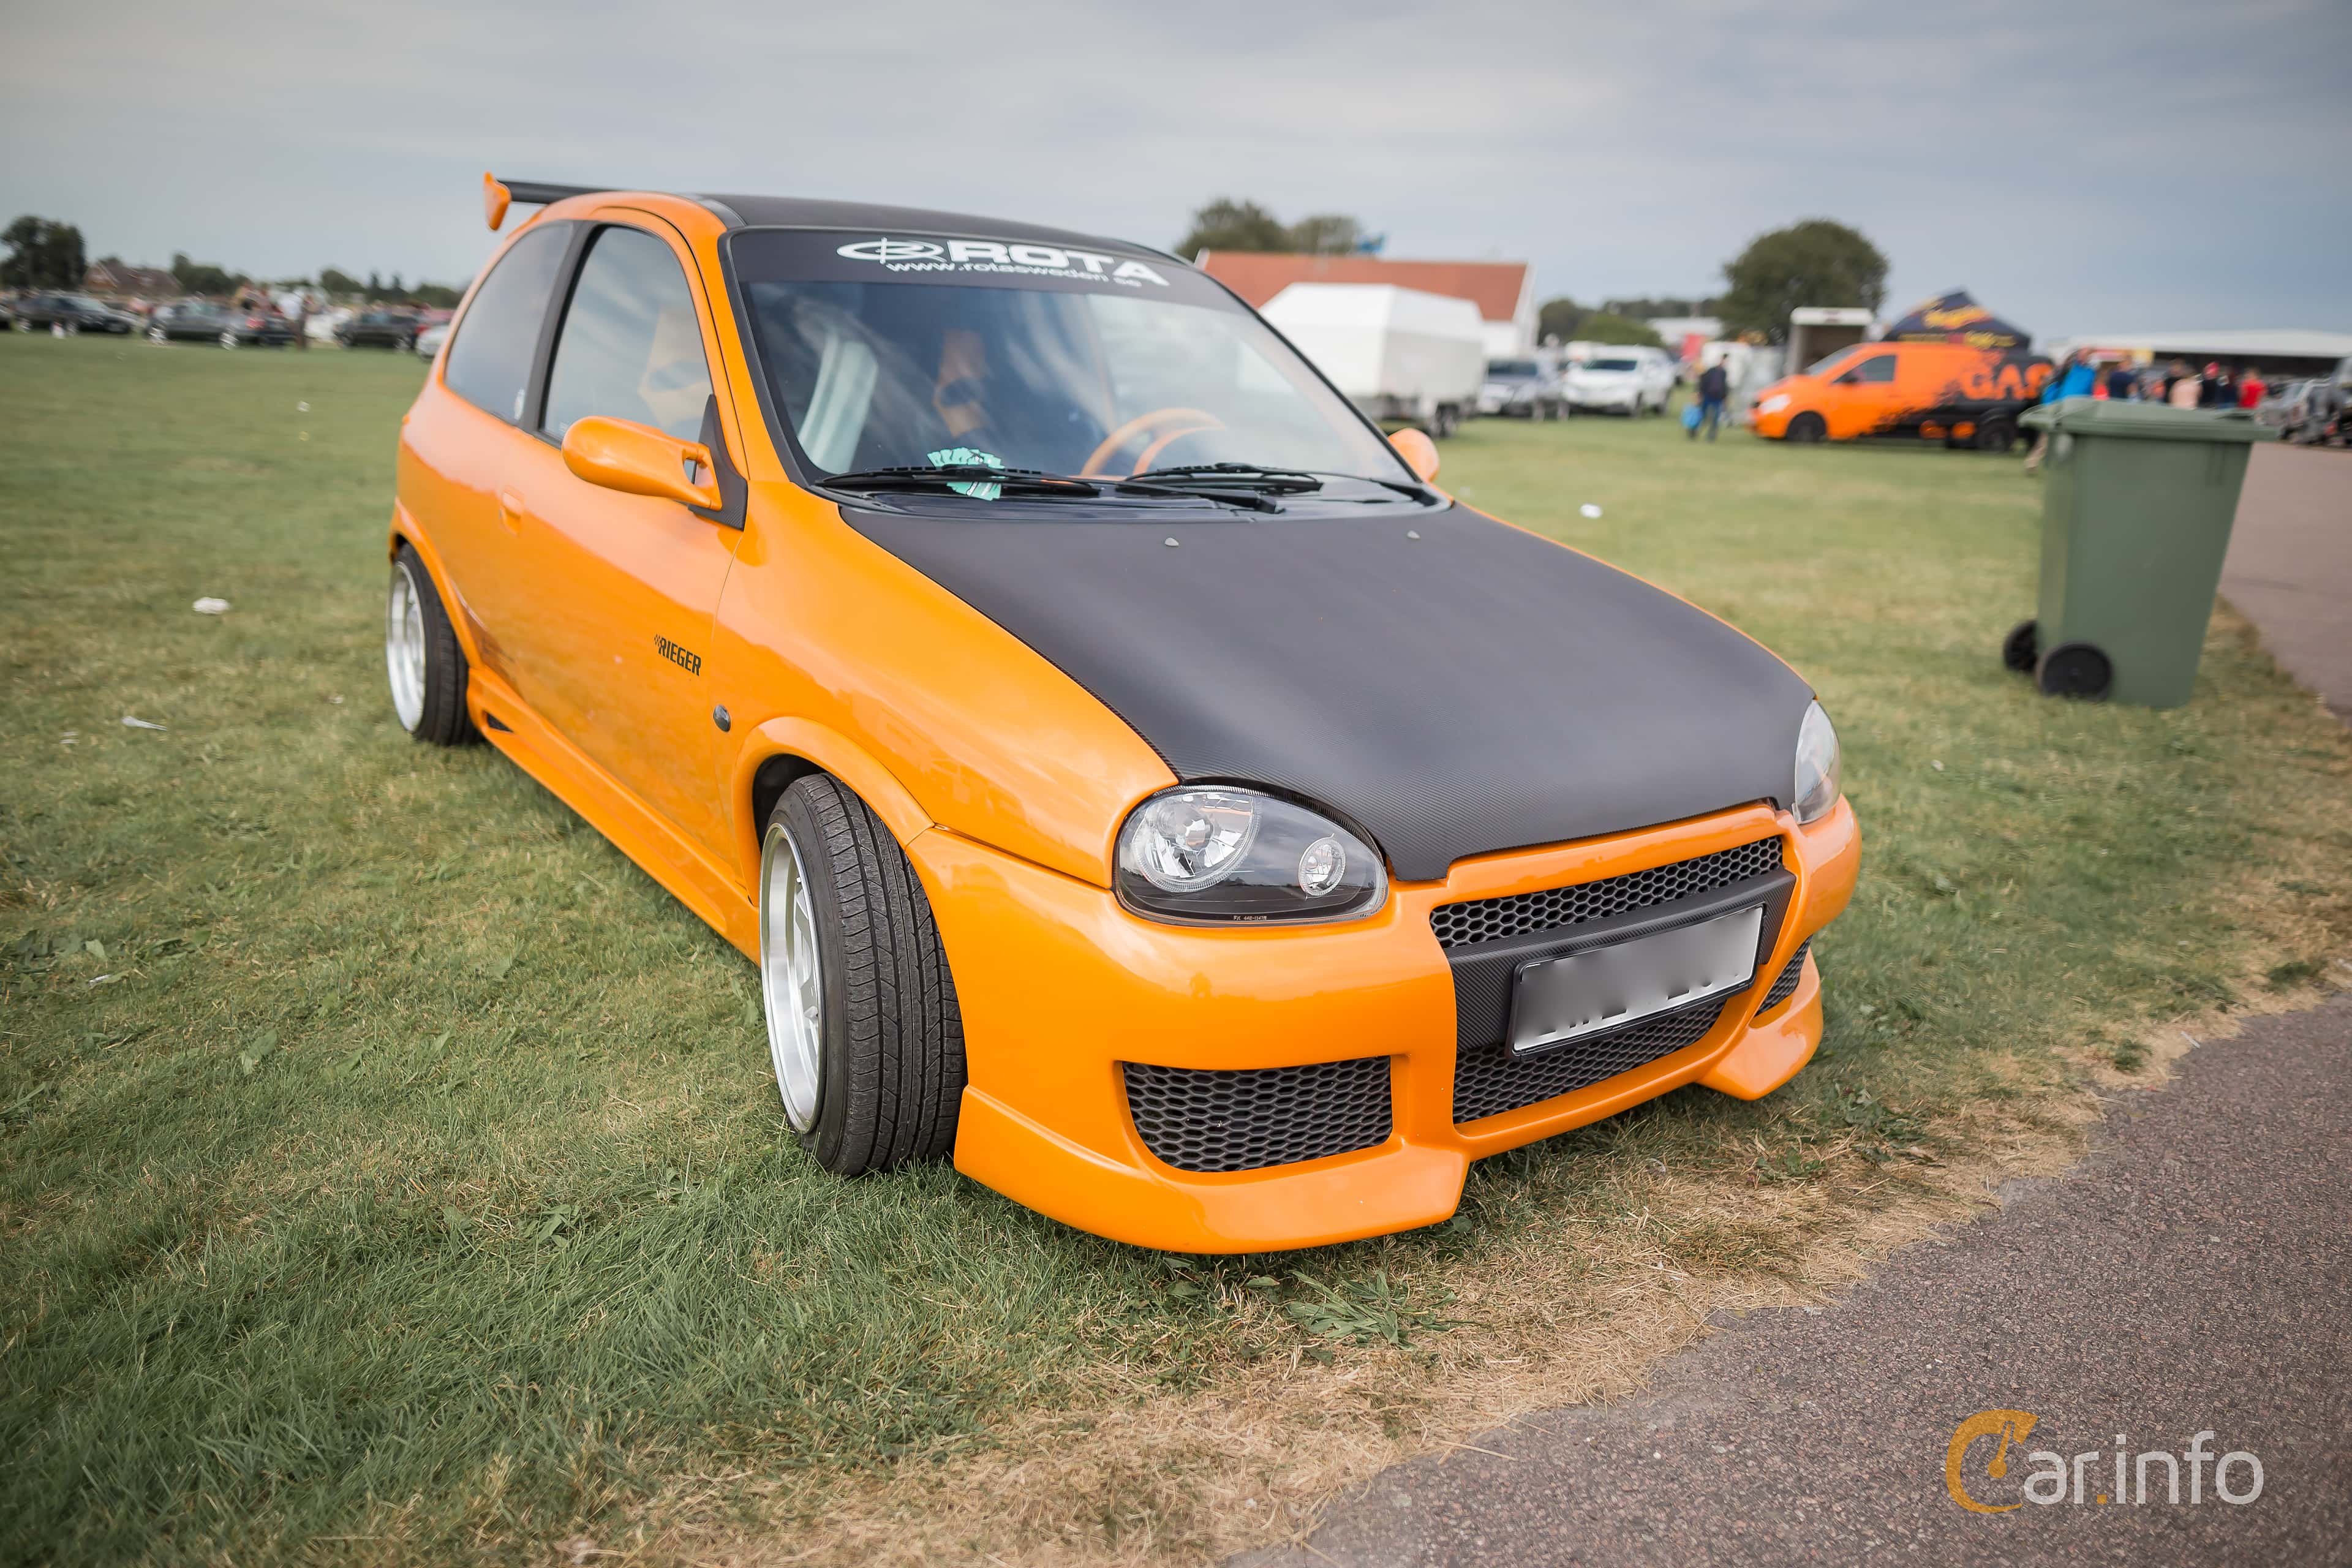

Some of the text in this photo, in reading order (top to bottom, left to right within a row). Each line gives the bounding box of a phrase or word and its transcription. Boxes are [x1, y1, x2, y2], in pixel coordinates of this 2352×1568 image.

[886, 262, 1142, 287] www.rotaswedense
[947, 239, 1170, 286] ROTA
[658, 637, 701, 676] RIEGER
